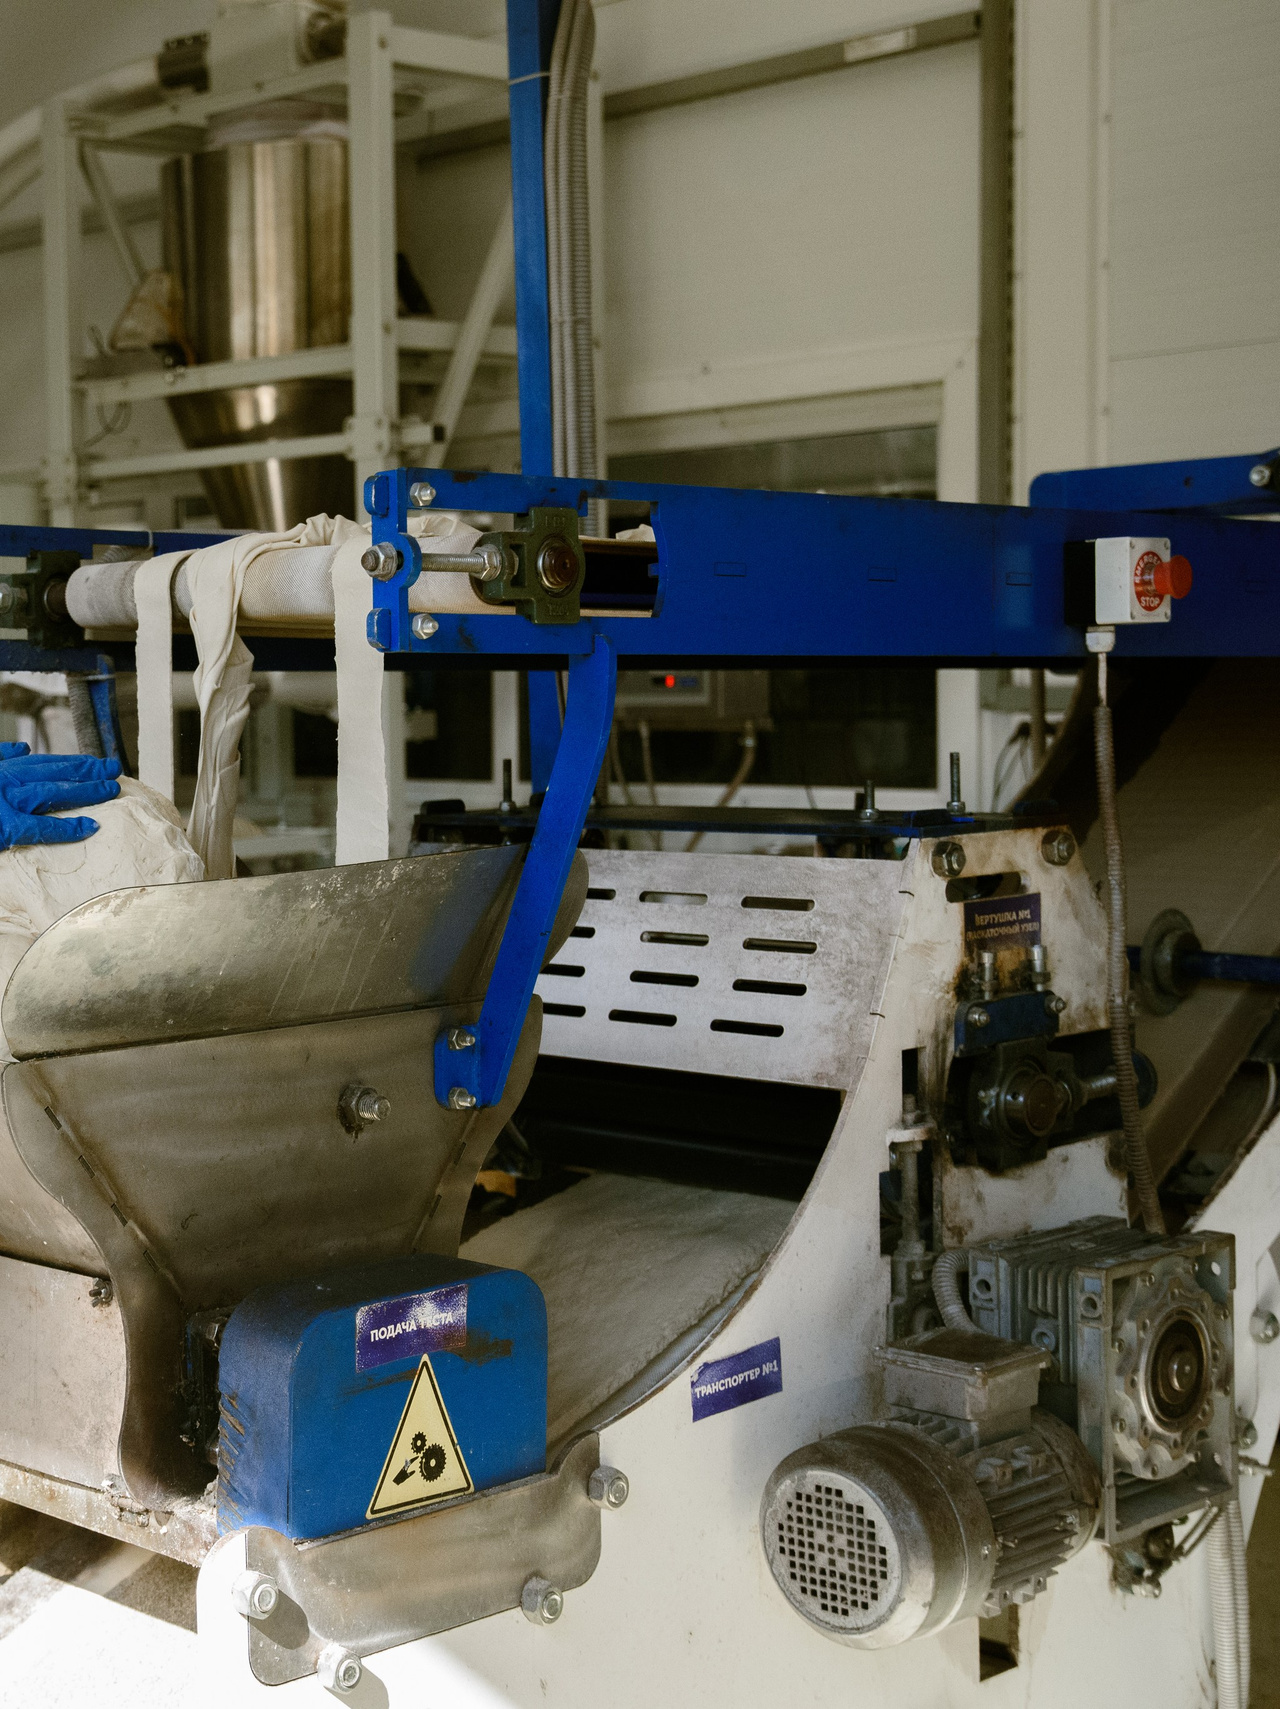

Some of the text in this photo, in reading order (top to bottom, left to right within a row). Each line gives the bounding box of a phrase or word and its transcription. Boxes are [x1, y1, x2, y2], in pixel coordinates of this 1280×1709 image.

[1140, 596, 1160, 608] STOP
[370, 1312, 453, 1342] ПОДАЧА ТЕСТА
[694, 1360, 778, 1399] ТРАНСПОРТЕР №1
